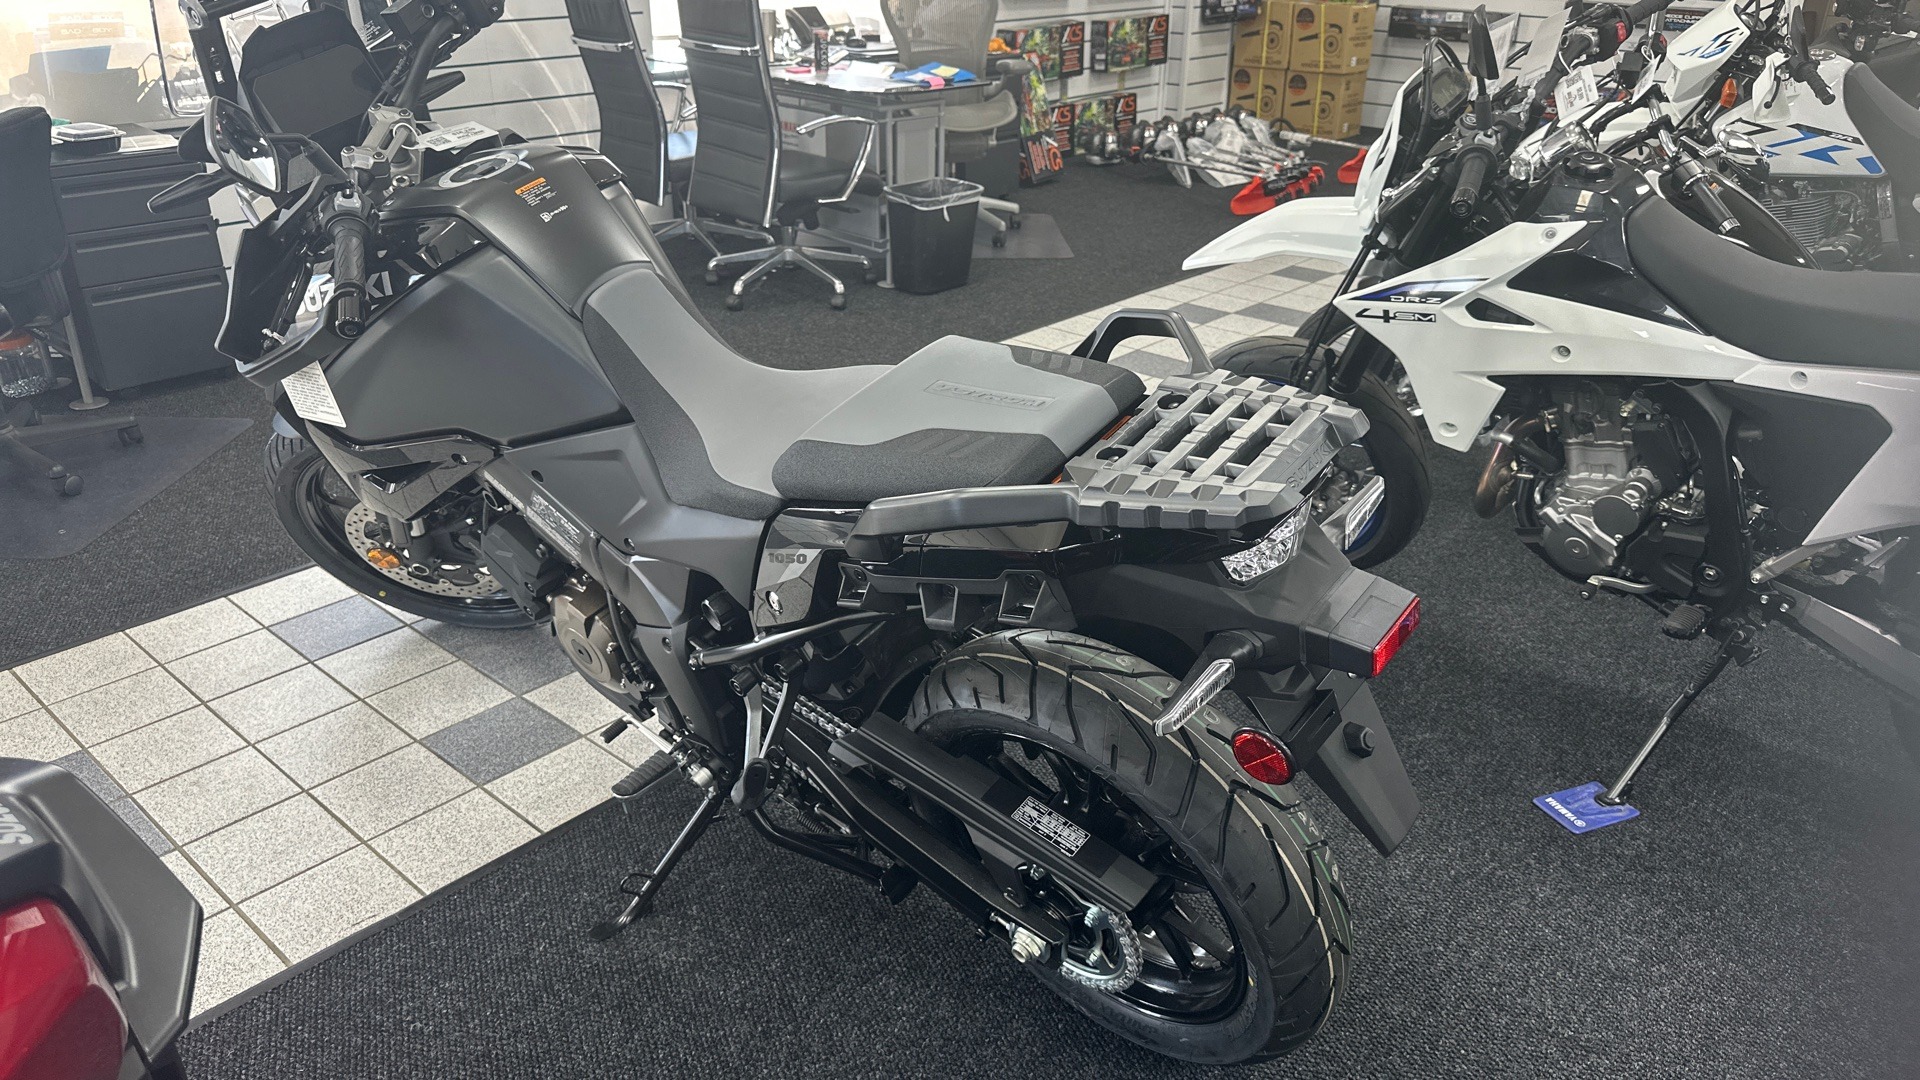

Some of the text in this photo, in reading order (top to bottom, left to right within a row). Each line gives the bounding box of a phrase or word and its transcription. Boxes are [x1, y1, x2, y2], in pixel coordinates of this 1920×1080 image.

[297, 270, 393, 315] UZKI
[1389, 295, 1442, 304] DR-Z
[1286, 440, 1335, 488] SUZUKI
[768, 552, 807, 564] 1050
[1545, 797, 1577, 822] YAMAHA
